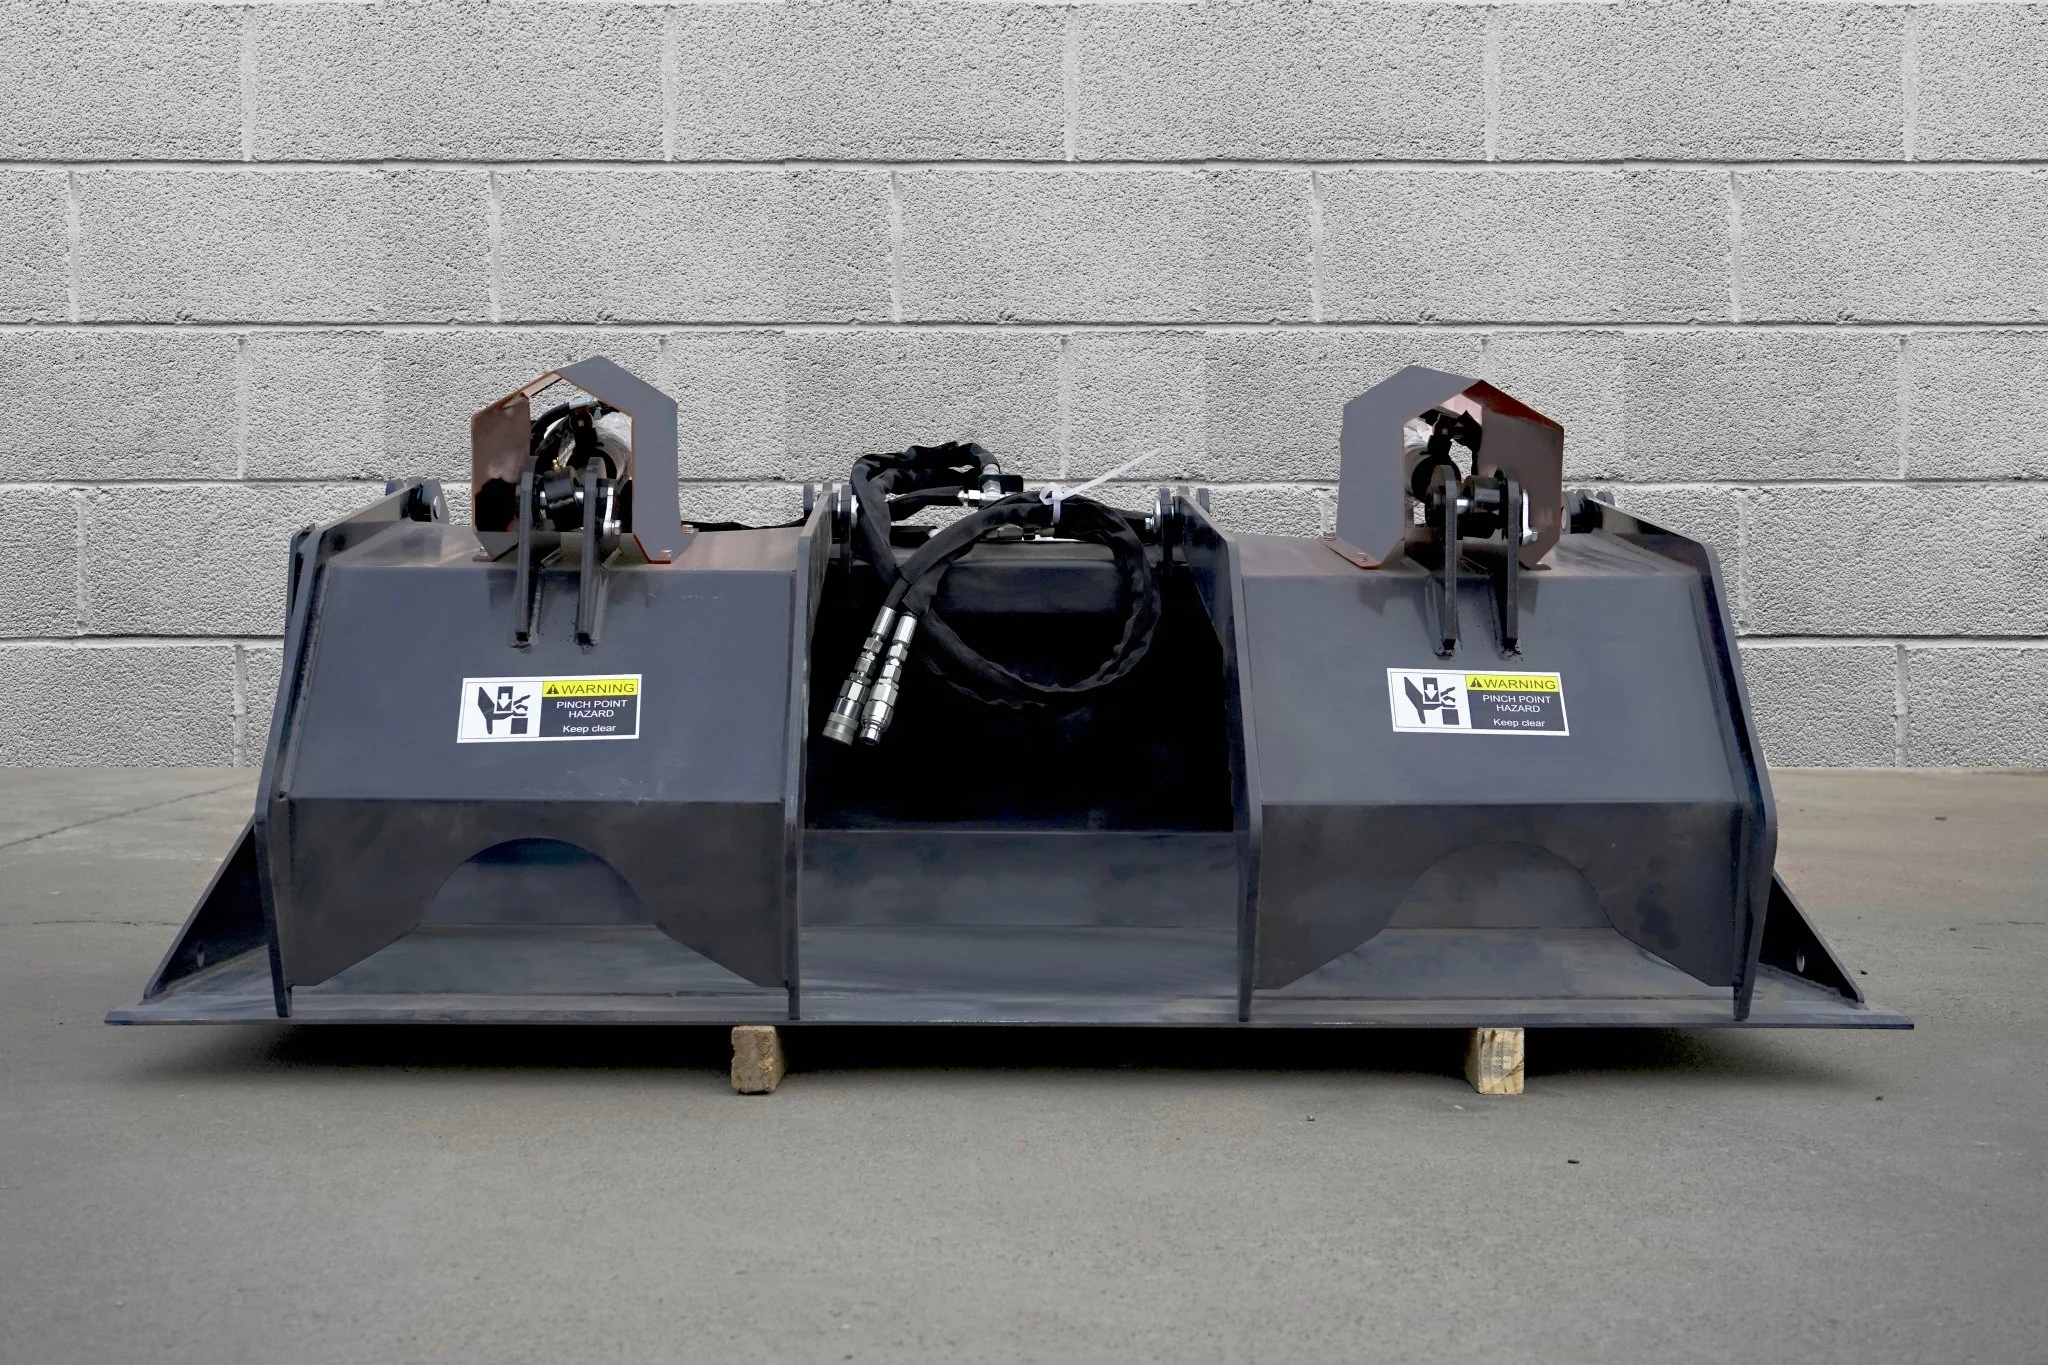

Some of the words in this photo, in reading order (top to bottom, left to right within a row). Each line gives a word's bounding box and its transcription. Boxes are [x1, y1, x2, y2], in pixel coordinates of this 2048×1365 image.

[561, 683, 635, 694] WARNING
[1484, 679, 1556, 690] WARNING
[556, 700, 591, 709] PINCH
[594, 699, 628, 708] POINT
[1482, 695, 1516, 703] PINCH
[1519, 695, 1552, 704] POINT
[568, 709, 614, 718] HAZARD
[1496, 704, 1541, 713] HAZARD
[1493, 718, 1519, 728] Keep
[1521, 719, 1545, 727] clear
[563, 724, 589, 734] Keep
[591, 724, 616, 732] clear
